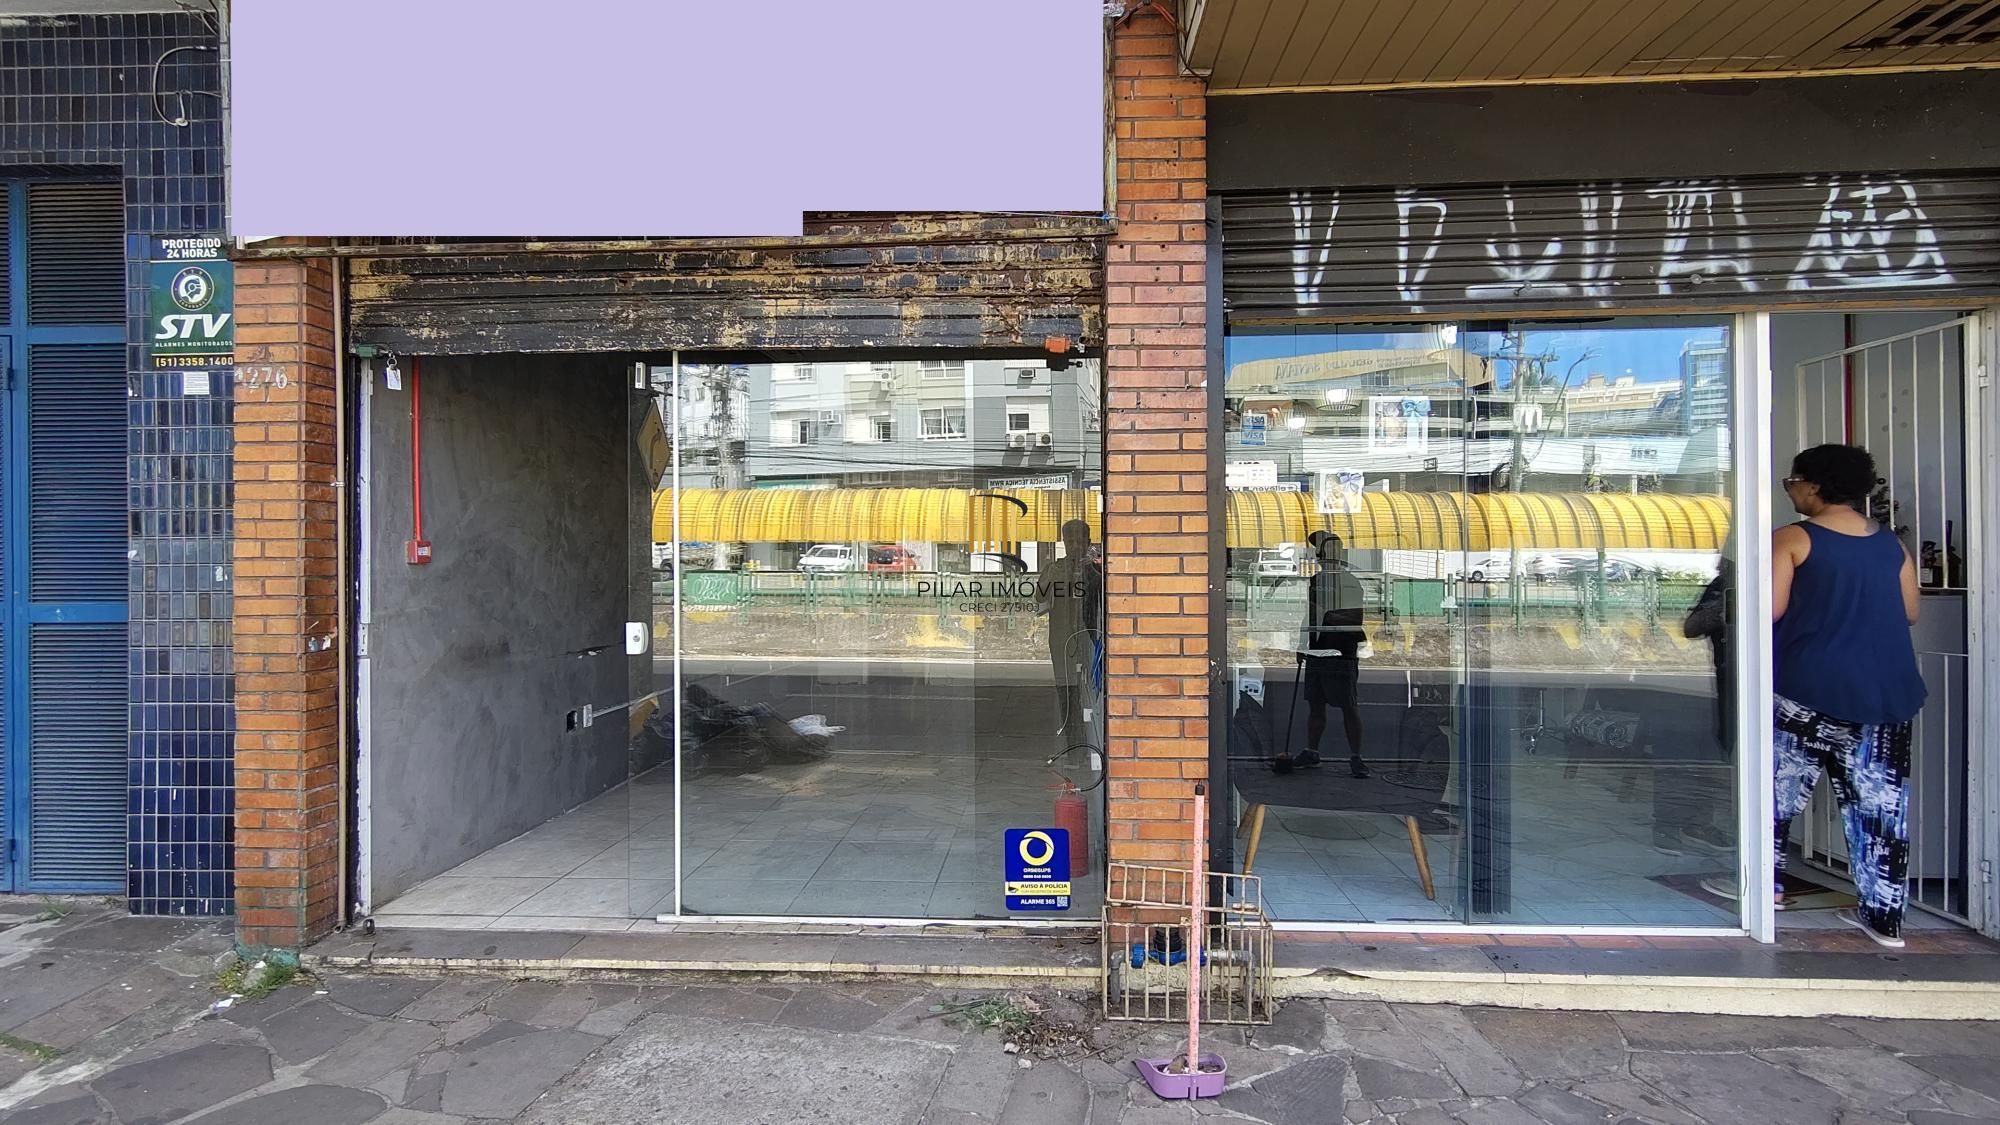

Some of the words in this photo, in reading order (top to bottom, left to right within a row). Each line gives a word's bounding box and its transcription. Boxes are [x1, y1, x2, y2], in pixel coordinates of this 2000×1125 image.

[162, 238, 221, 249] PROTEGIDO
[166, 249, 180, 259] 24
[182, 248, 218, 258] HORAS
[155, 313, 232, 340] STV
